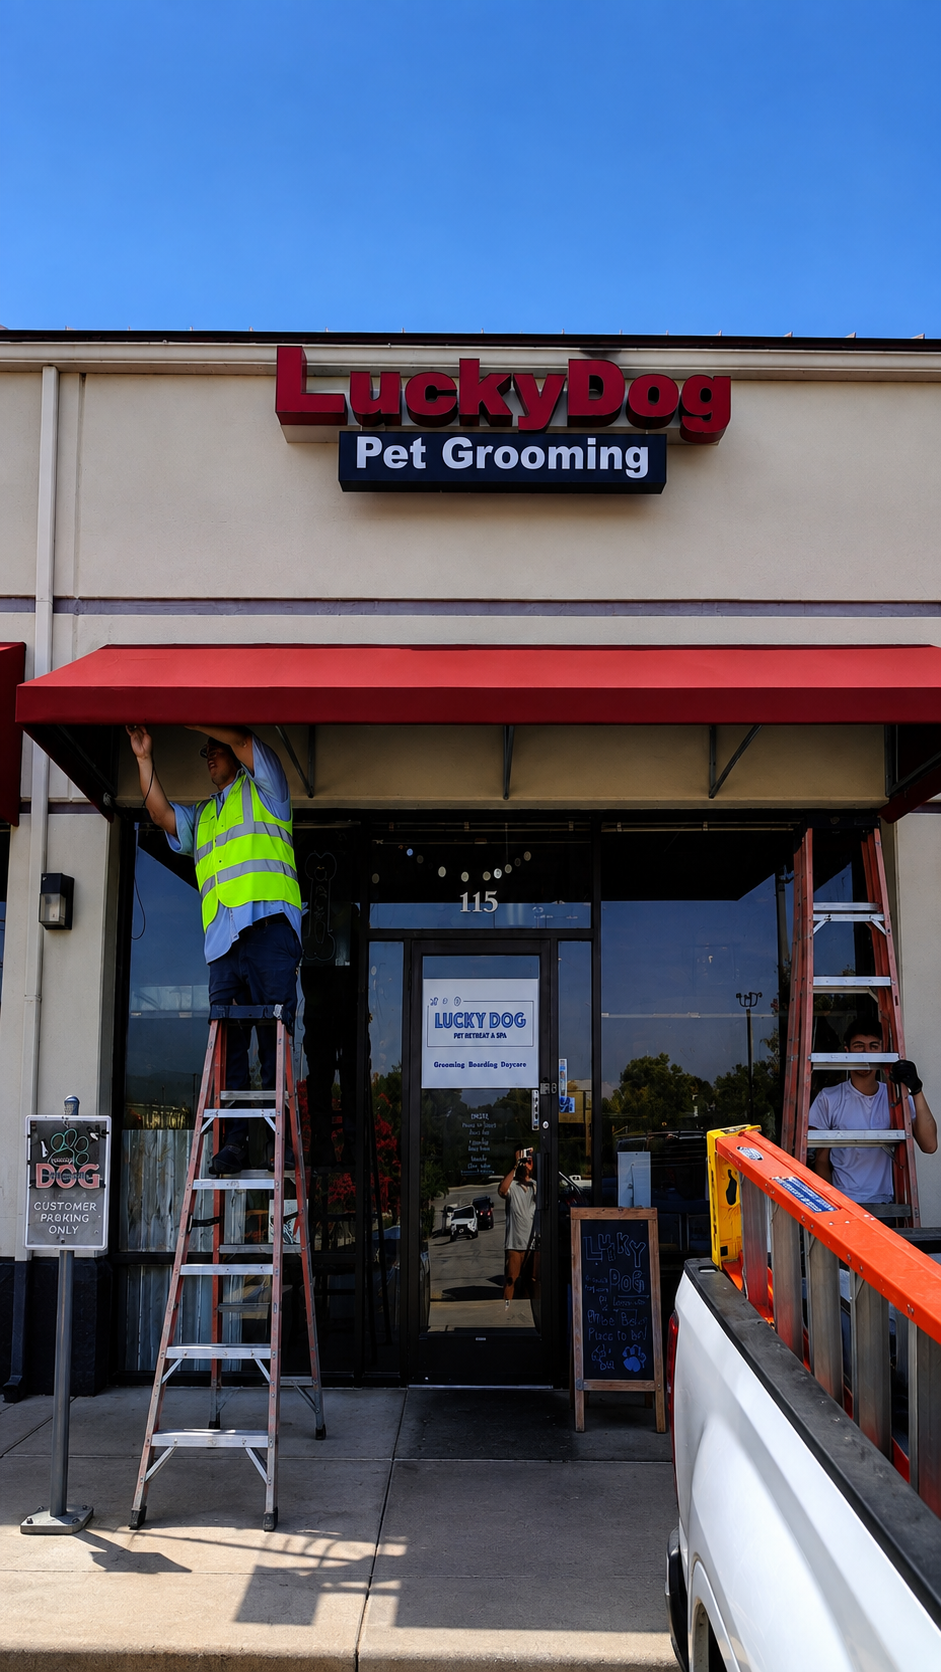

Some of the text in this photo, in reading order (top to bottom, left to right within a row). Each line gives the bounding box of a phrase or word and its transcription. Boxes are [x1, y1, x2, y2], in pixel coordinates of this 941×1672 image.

[356, 436, 649, 479] Pet Grooming
[459, 890, 499, 913] 115
[434, 1012, 527, 1029] LUCKY DOG
[433, 1061, 465, 1069] Grooming
[468, 1061, 498, 1069] Boarding
[36, 1163, 100, 1189] DOG
[34, 1202, 97, 1211] CUSTOMER
[48, 1225, 79, 1235] ONLY
